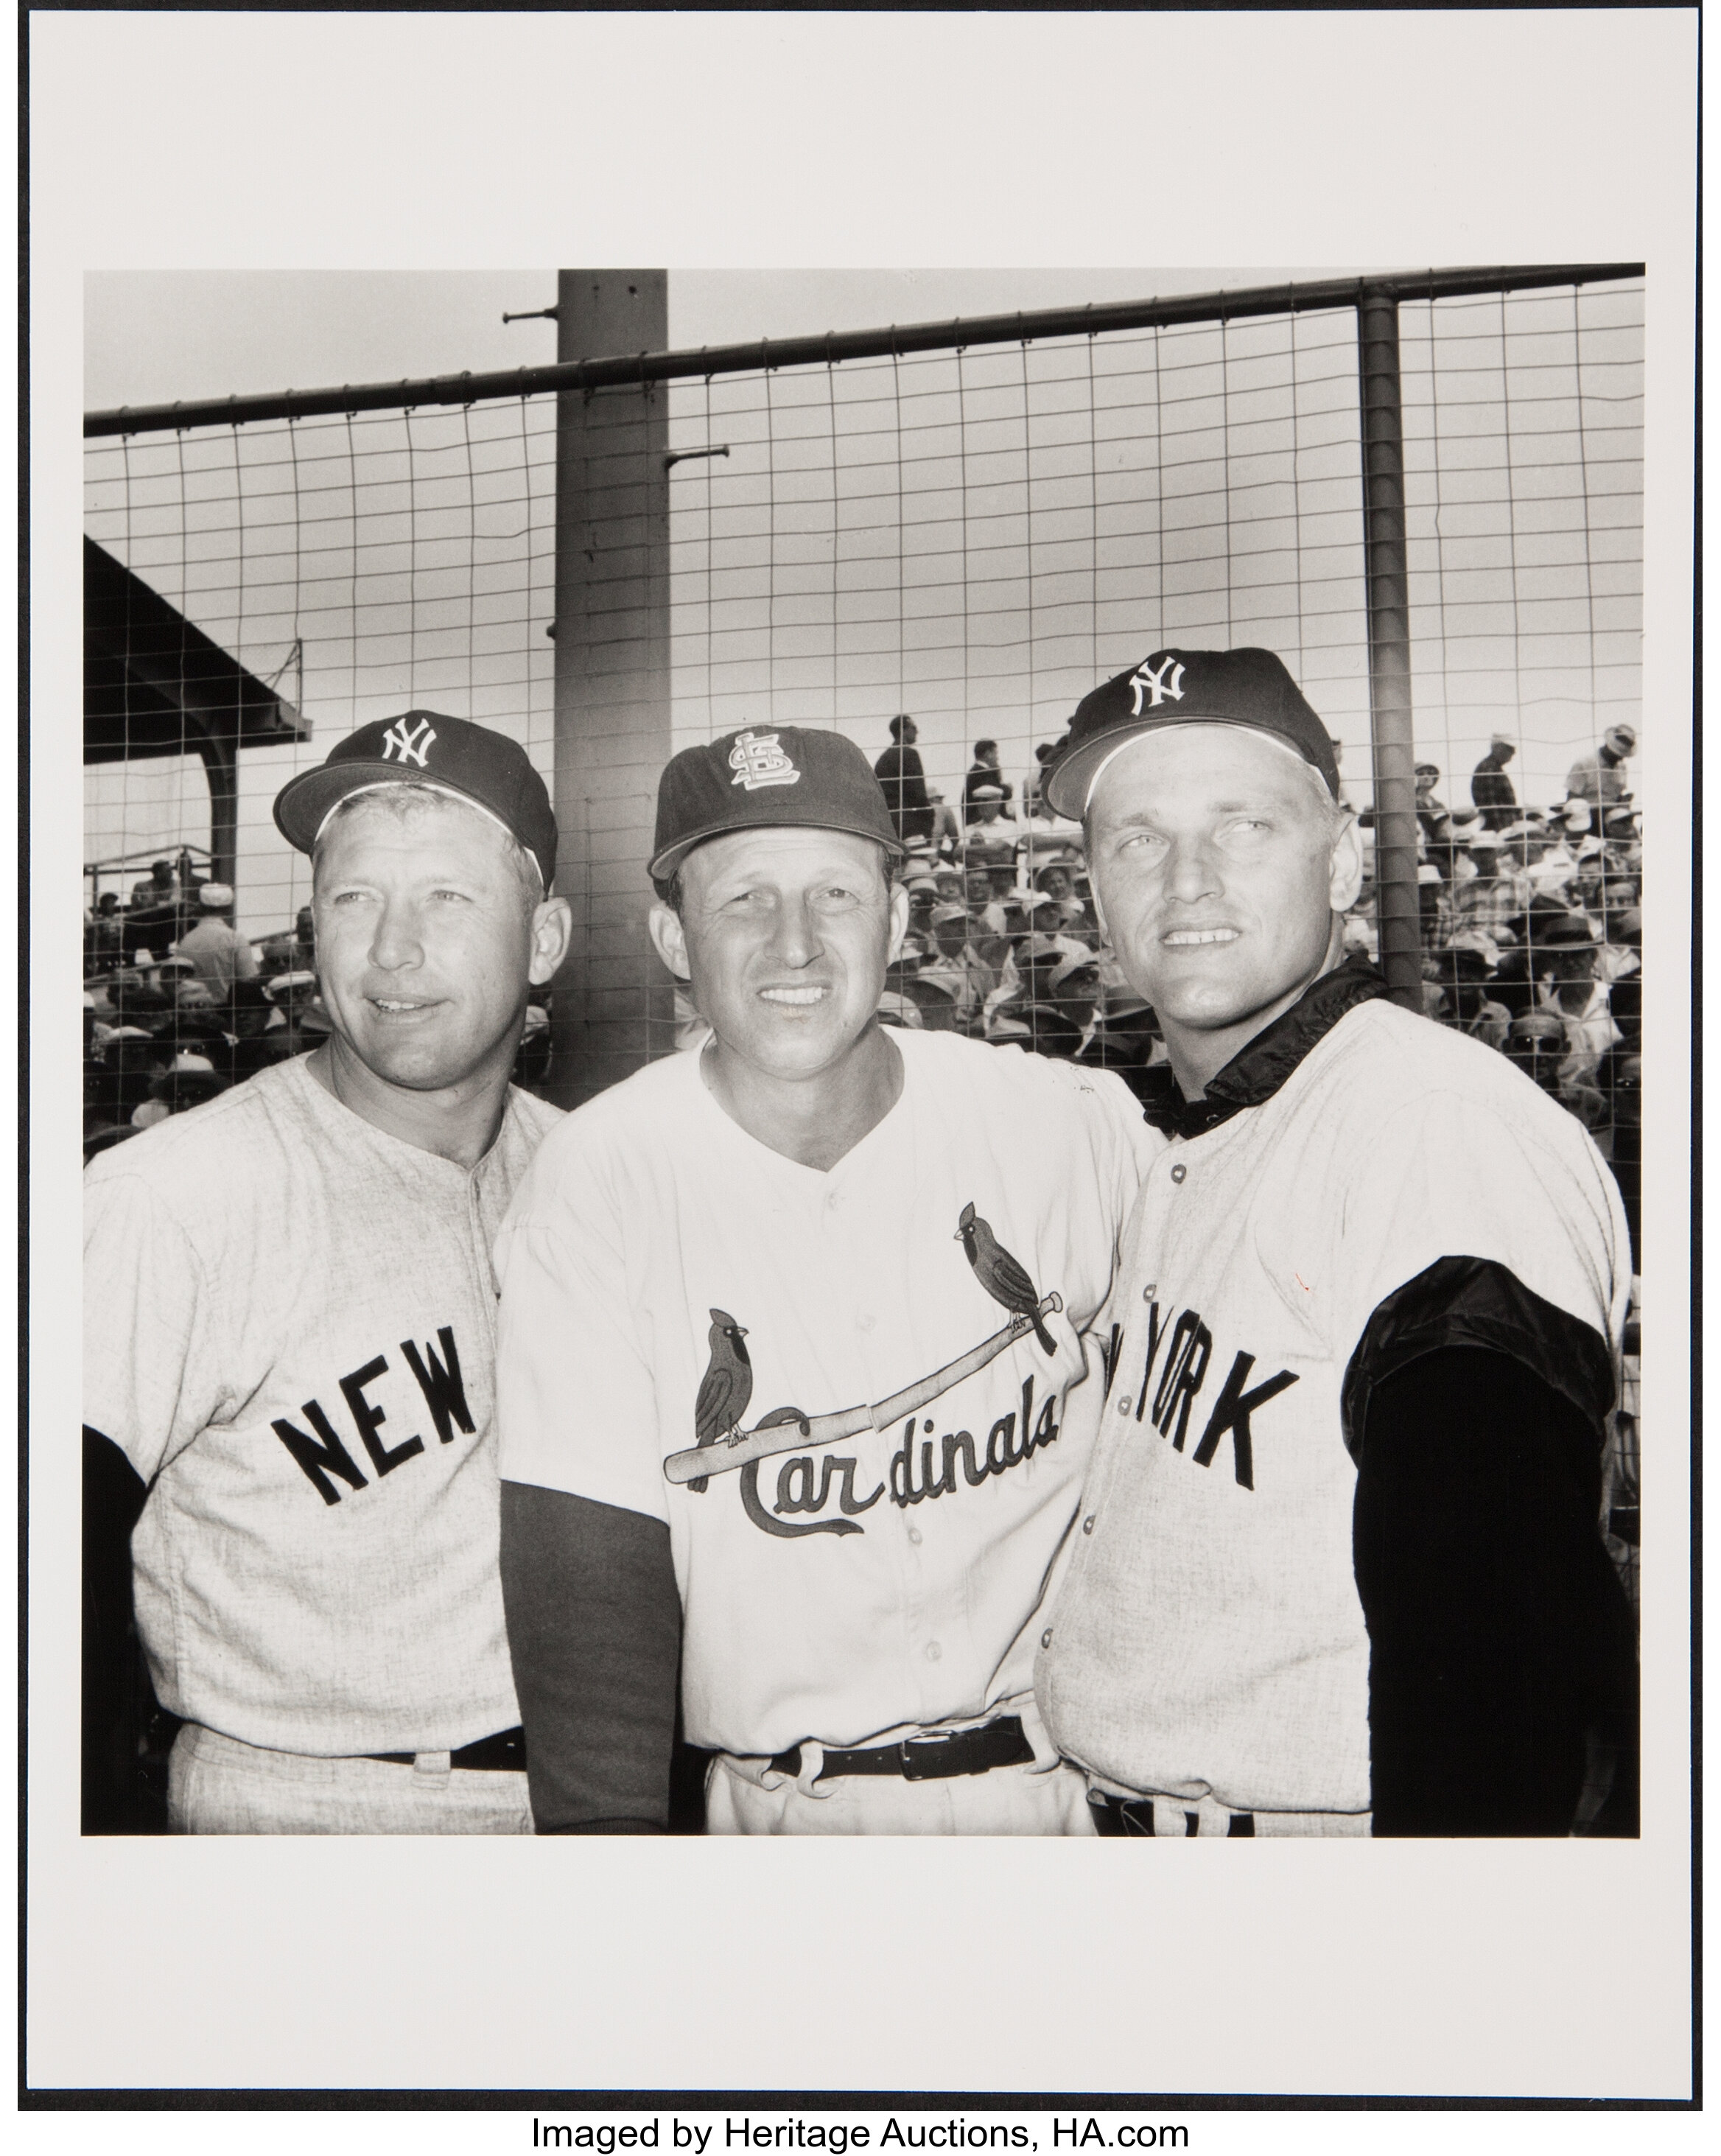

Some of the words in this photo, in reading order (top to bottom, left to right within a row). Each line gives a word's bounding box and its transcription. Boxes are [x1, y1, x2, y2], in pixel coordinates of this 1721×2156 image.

[382, 718, 437, 768] NY
[1129, 656, 1185, 716] NY
[270, 1326, 476, 1506] NEW
[740, 1374, 1059, 1539] Cardinals
[1136, 1302, 1300, 1491] YORK
